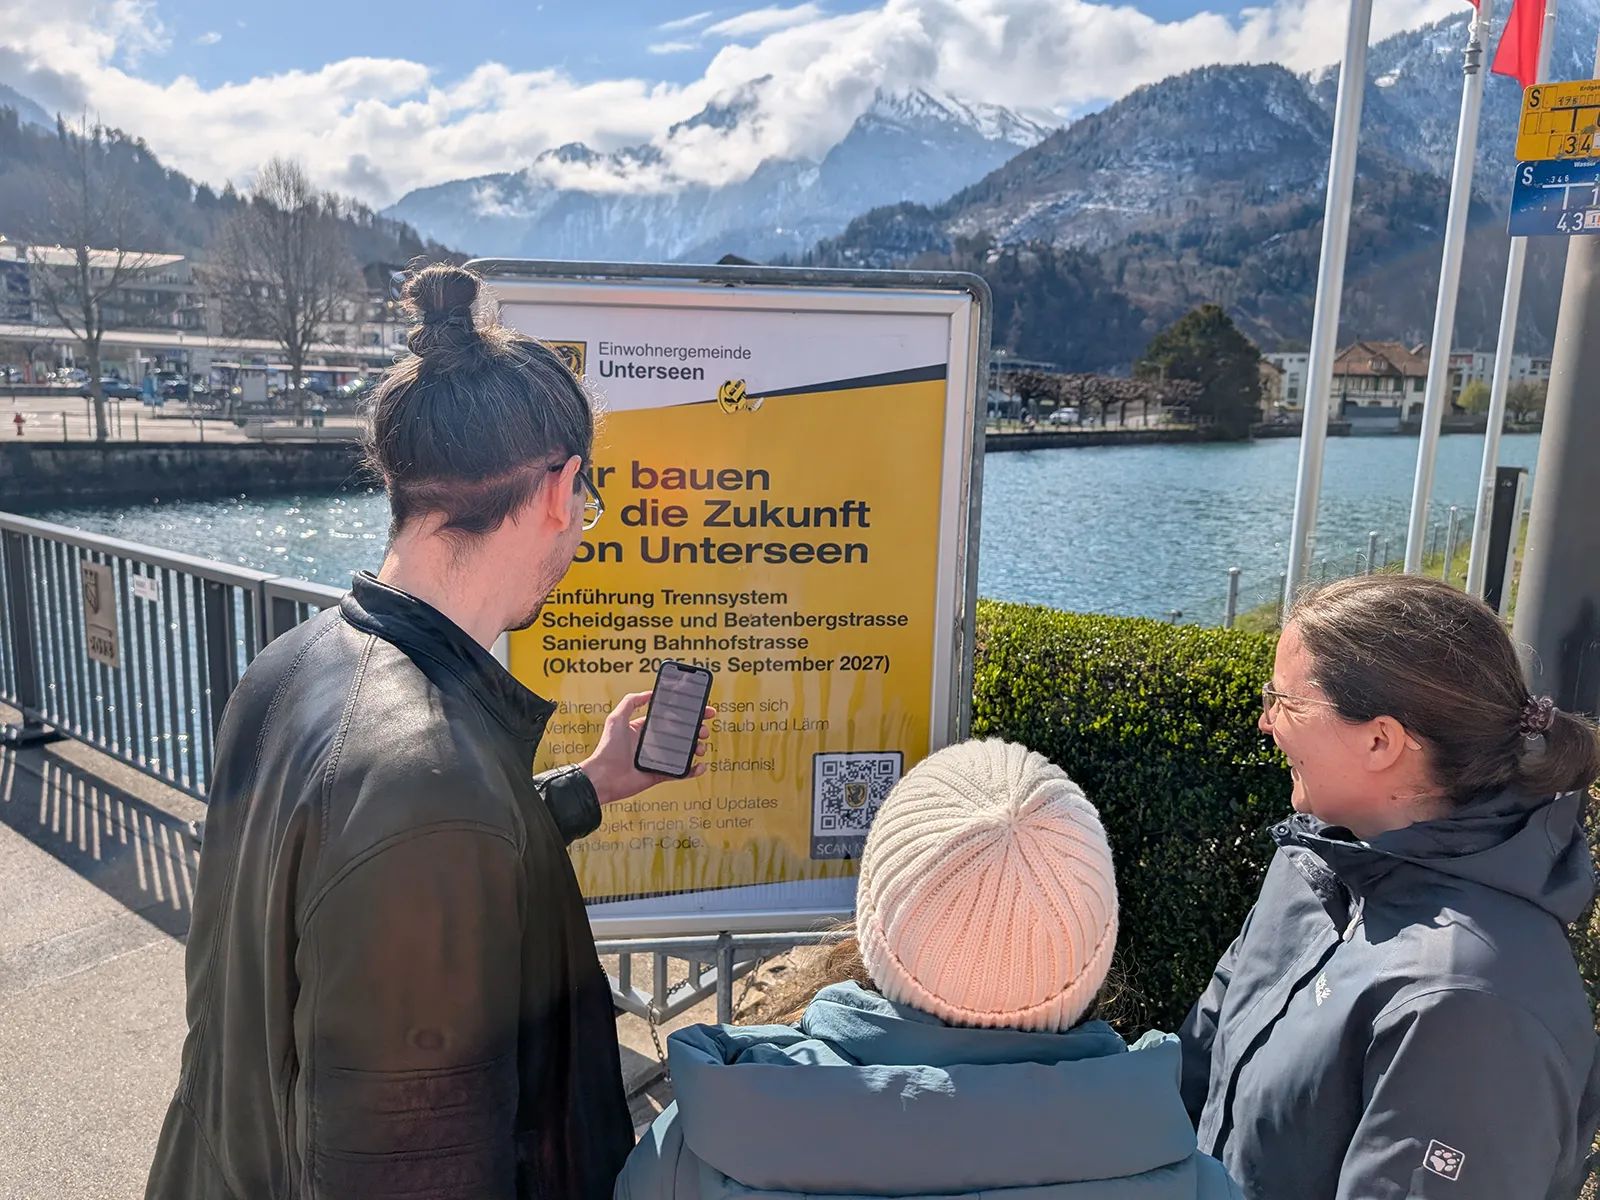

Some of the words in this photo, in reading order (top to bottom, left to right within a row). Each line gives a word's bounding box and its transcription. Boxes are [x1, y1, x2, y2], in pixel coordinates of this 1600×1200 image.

[1530, 88, 1541, 108] S
[1522, 166, 1534, 185] S
[599, 341, 752, 361] Einwohnergemeinde
[600, 360, 705, 380] Unterseen
[588, 460, 616, 488] ir
[631, 460, 770, 491] bauen
[620, 499, 688, 527] die
[703, 500, 871, 528] Zukunft
[572, 540, 624, 563] on
[640, 536, 869, 564] Unterseen
[545, 589, 655, 608] Einführung
[661, 589, 788, 607] Trennsystem
[542, 611, 673, 631] Scheidgasse
[681, 612, 718, 629] und
[724, 611, 908, 630] Beatenbergstrasse
[542, 635, 647, 653] Sanierung
[653, 634, 809, 651] Bahnhofstrasse
[543, 657, 634, 678] (Oktober
[639, 658, 686, 673] 20
[727, 656, 835, 676] September
[839, 655, 890, 674] 2027)
[759, 697, 788, 712] sich
[711, 719, 755, 733] Staub
[761, 718, 787, 731] und
[793, 716, 830, 732] Lärm
[549, 741, 589, 755] leider
[684, 799, 711, 811] und
[717, 796, 778, 812] Updates
[600, 821, 633, 834] ojekt
[639, 818, 684, 831] finden
[689, 816, 711, 829] Sie
[716, 815, 753, 828] unter
